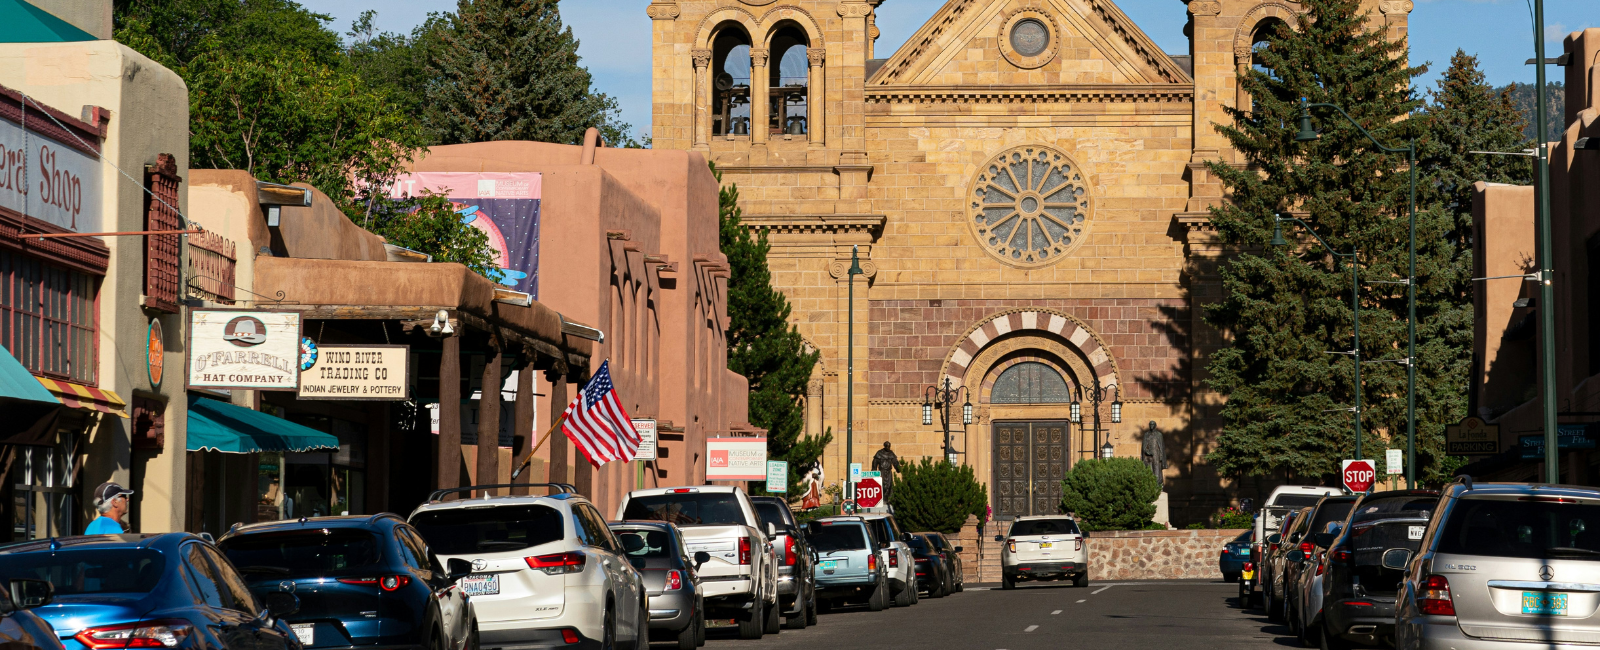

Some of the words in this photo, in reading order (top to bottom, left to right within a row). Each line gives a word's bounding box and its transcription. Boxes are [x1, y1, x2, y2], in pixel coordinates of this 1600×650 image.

[40, 145, 81, 231] Shop
[195, 351, 293, 375] O'FARRELL
[326, 352, 351, 364] WIND
[355, 352, 383, 364] RIVER
[203, 374, 226, 382] HAT
[229, 374, 284, 383] COMPANY
[320, 367, 369, 380] TRADING
[375, 368, 388, 380] CO
[303, 385, 326, 393] INDIAN
[328, 385, 360, 394] JEWELRY
[362, 386, 368, 394] &
[370, 386, 402, 394] POTTERY
[1458, 429, 1466, 438] La
[1467, 429, 1487, 440] Fonda
[1557, 428, 1585, 437] STREET
[1452, 442, 1494, 451] PARKING
[1345, 470, 1374, 483] STOP
[857, 487, 880, 499] STOP
[464, 581, 497, 593] BNA0490
[1523, 596, 1540, 608] RBC
[1551, 597, 1567, 609] 383
